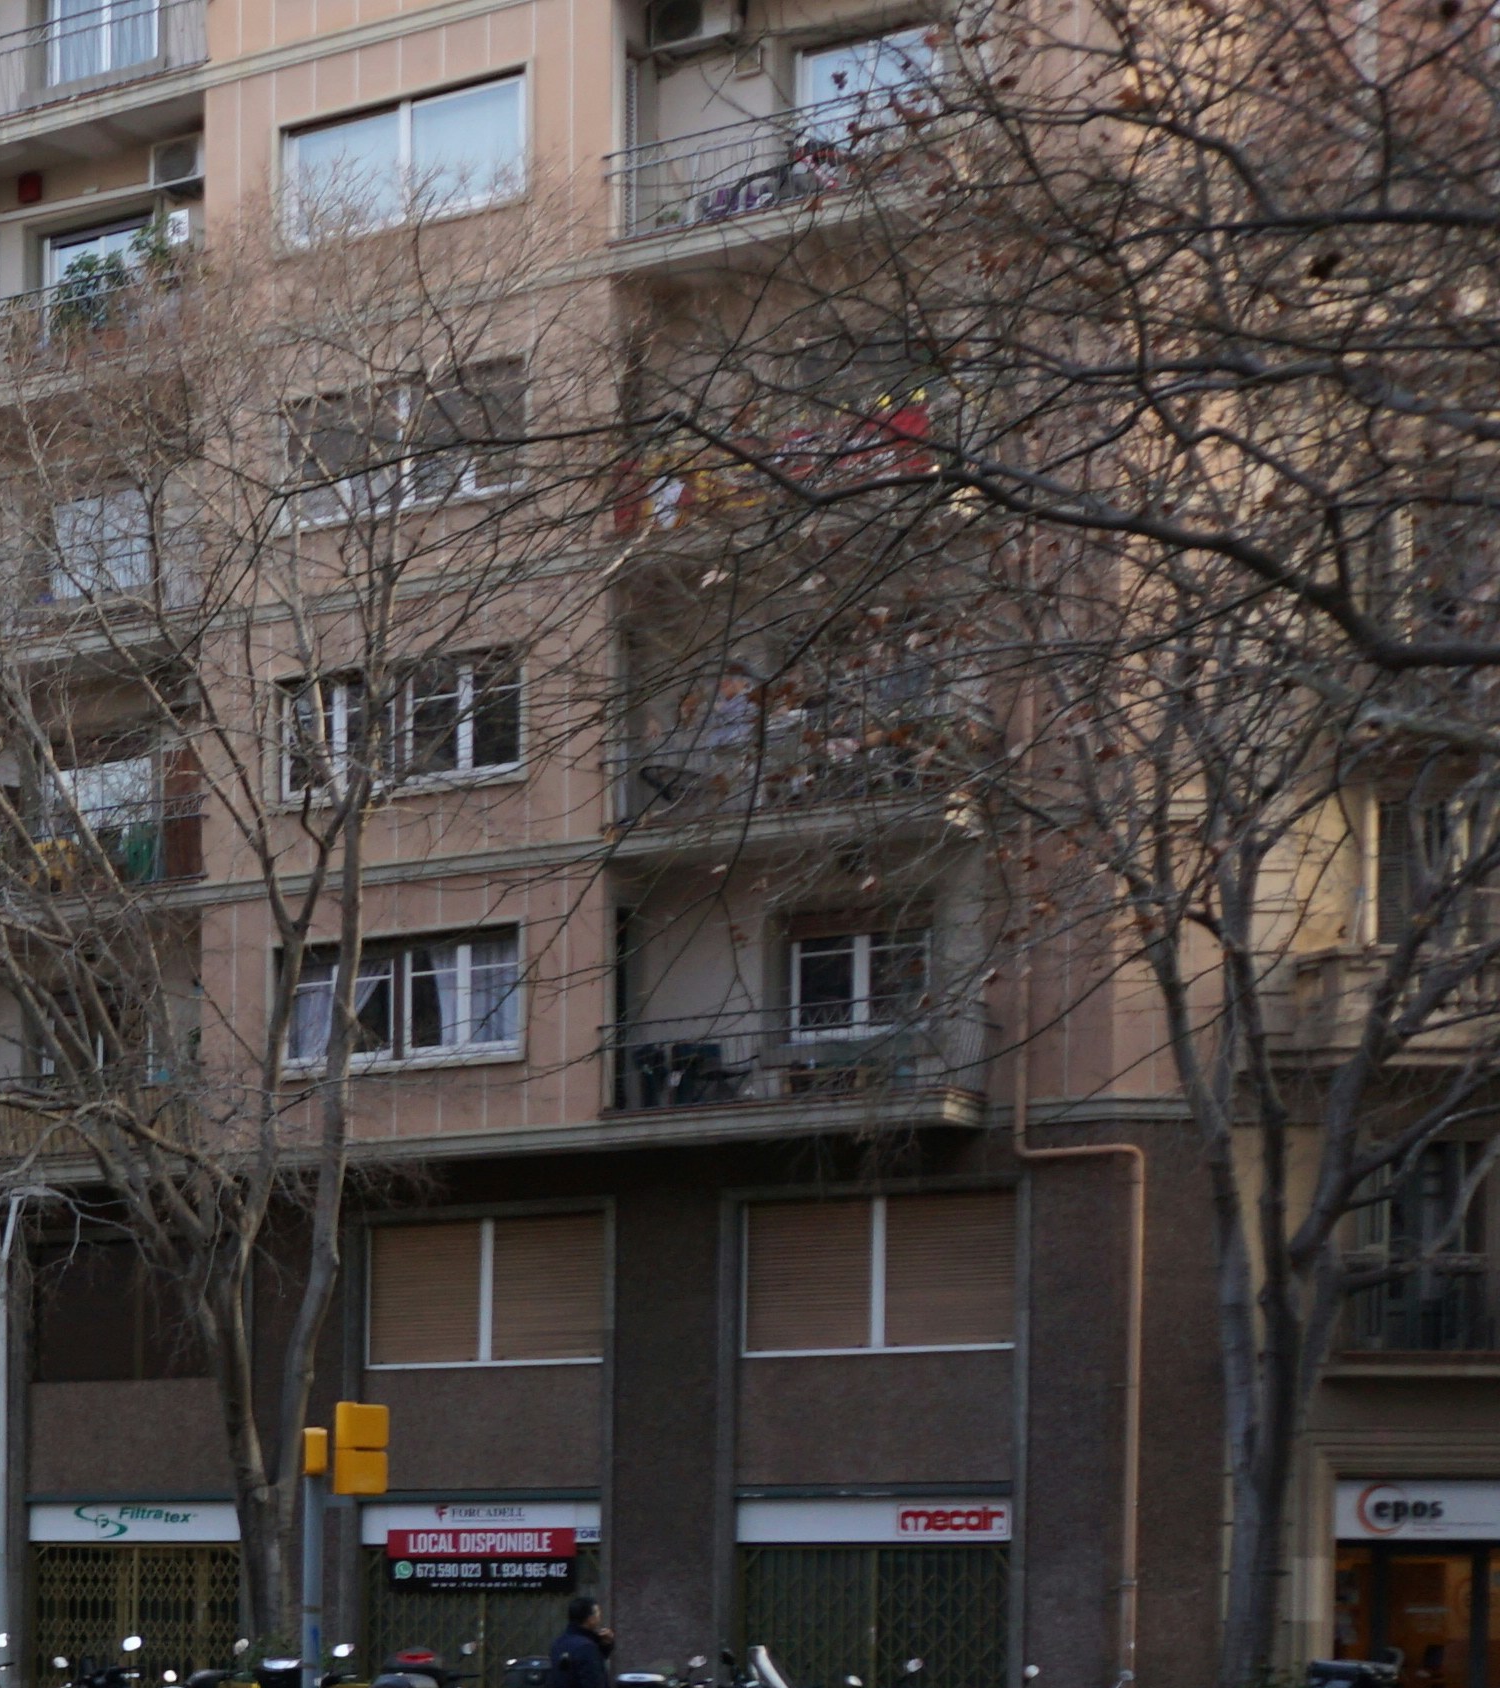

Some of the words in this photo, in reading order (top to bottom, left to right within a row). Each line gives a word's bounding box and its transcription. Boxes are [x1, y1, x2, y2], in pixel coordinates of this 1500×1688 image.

[119, 1506, 192, 1523] Filtratex
[452, 1506, 525, 1517] FORCADELL
[1373, 1500, 1444, 1523] epos
[408, 1533, 456, 1553] LOCAL
[459, 1532, 553, 1553] DISPONIBLE
[416, 1563, 436, 1578] 673
[460, 1563, 482, 1578] 023
[502, 1563, 523, 1578] 934
[525, 1563, 547, 1578] 965
[549, 1563, 568, 1578] 412
